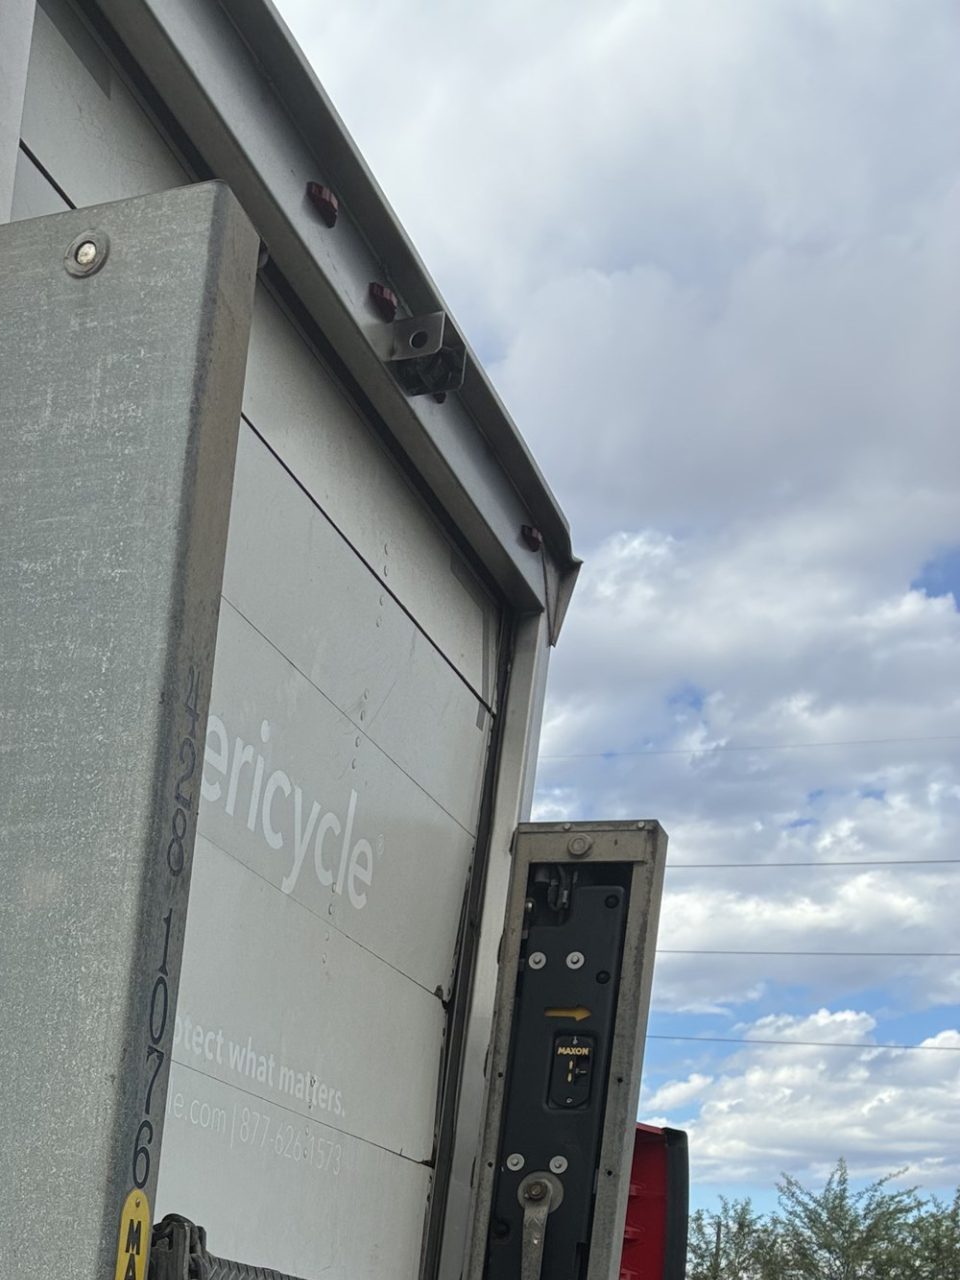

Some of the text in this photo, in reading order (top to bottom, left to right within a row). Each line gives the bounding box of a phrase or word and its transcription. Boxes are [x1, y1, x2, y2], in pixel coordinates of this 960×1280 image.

[557, 1047, 589, 1056] MAXON
[229, 1036, 276, 1087] what
[279, 1065, 346, 1118] matters.
